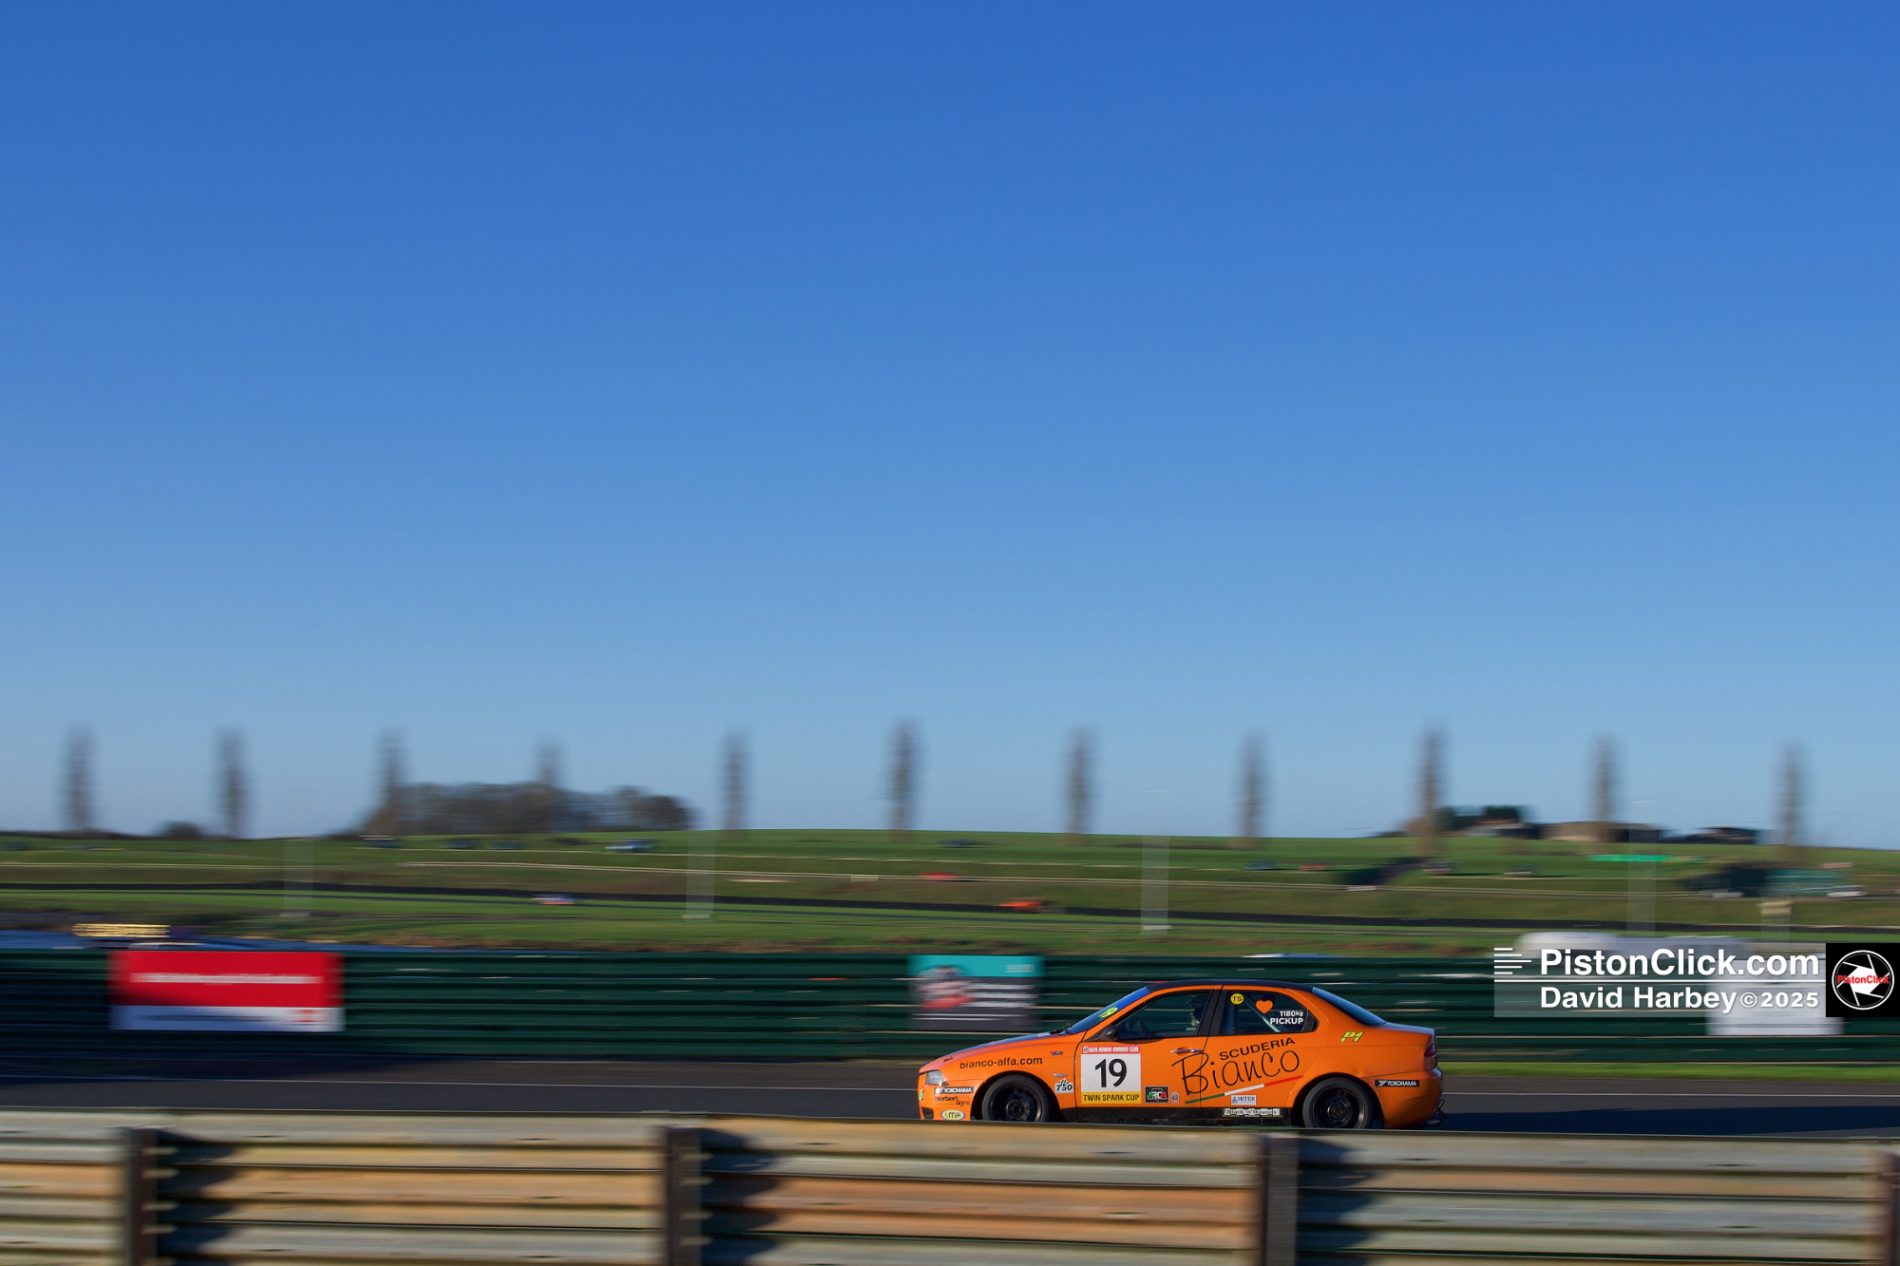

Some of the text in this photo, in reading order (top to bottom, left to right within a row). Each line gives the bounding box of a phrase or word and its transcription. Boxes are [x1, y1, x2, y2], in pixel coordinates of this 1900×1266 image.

[1269, 1017, 1304, 1025] PICKUP
[1219, 1037, 1296, 1061] SCUDERIA
[959, 1056, 1043, 1070] bianco-alfa.com
[1094, 1058, 1128, 1088] 19
[1083, 1094, 1101, 1102] TWIN
[1102, 1094, 1124, 1102] SPARK
[1125, 1094, 1140, 1102] CUP
